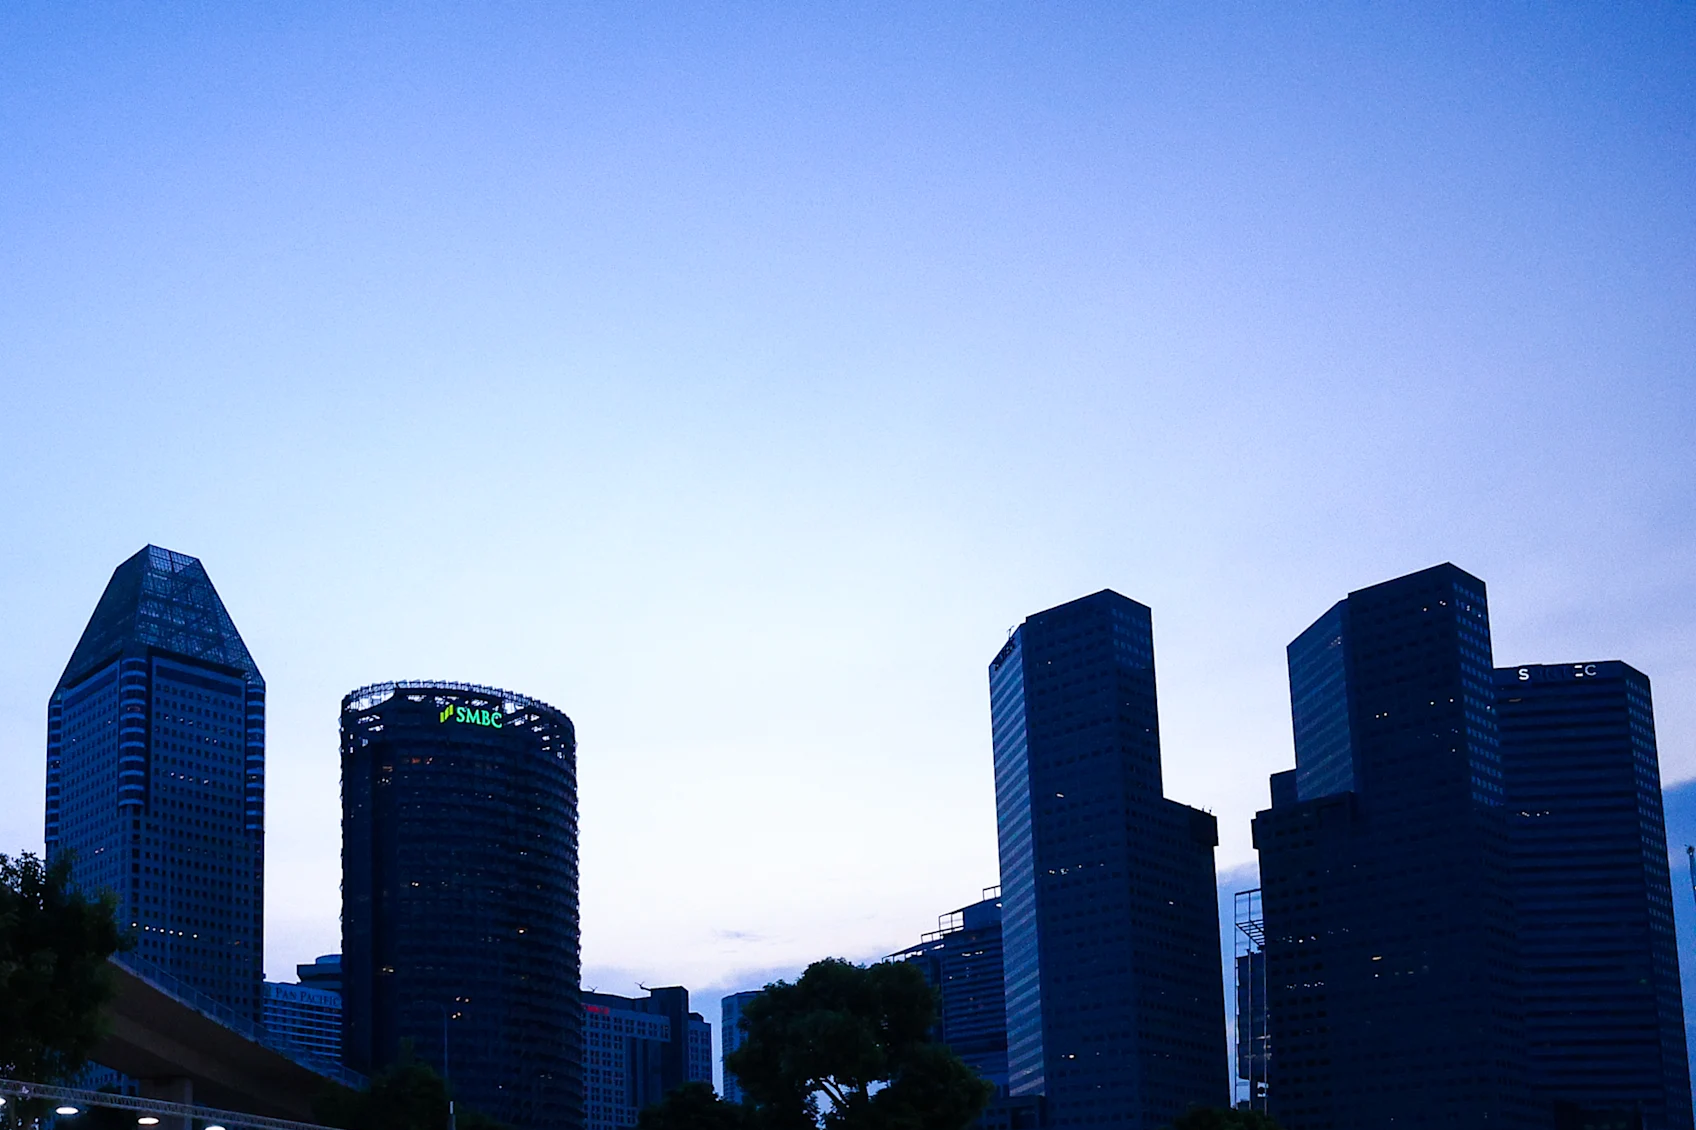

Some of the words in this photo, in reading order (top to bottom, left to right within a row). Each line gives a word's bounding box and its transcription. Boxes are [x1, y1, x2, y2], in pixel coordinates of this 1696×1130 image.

[456, 706, 503, 728] SMBC
[276, 987, 297, 999] PAN
[300, 991, 340, 1007] PACIFIC
